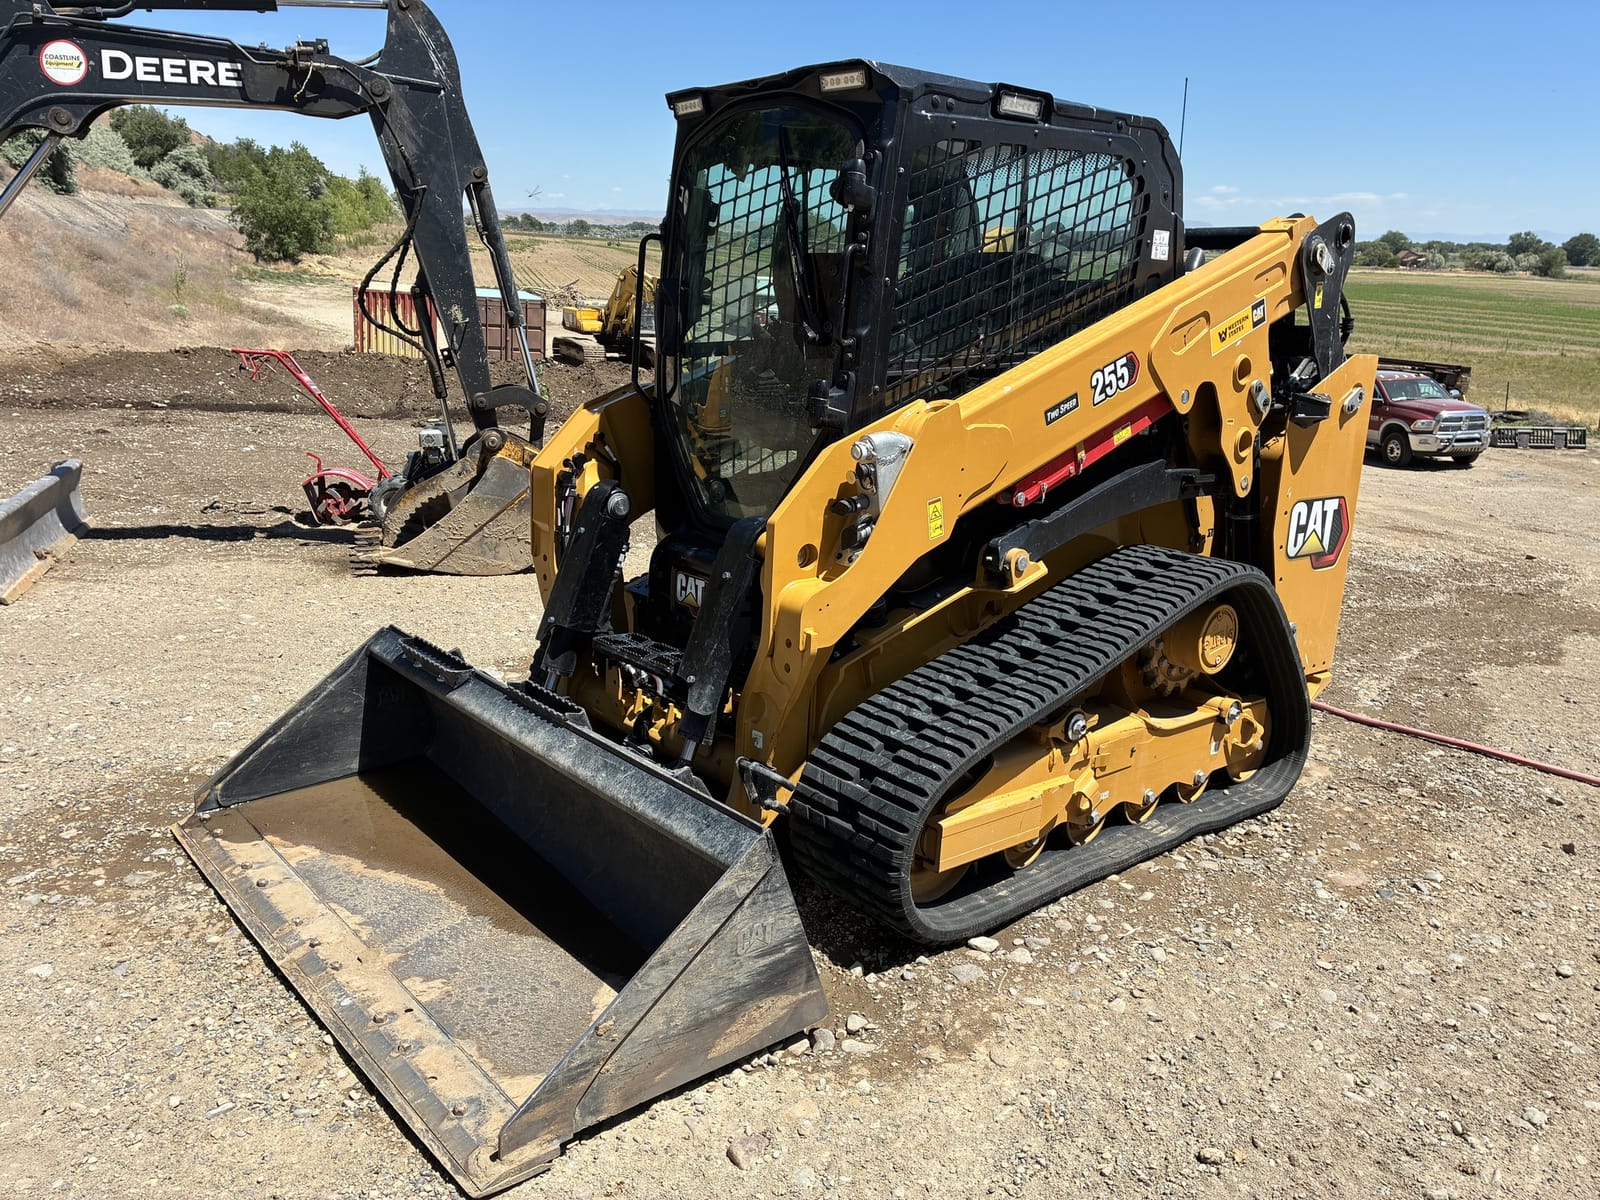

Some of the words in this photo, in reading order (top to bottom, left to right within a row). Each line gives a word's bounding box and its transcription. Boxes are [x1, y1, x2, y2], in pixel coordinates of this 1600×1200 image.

[44, 53, 80, 61] COASTLINE
[100, 49, 243, 87] DEERE
[1228, 314, 1250, 331] WESTERN
[1228, 324, 1245, 338] STATES
[1091, 356, 1130, 405] 255
[1287, 498, 1340, 557] CAT
[676, 573, 705, 607] CAT
[736, 919, 775, 956] CAT
